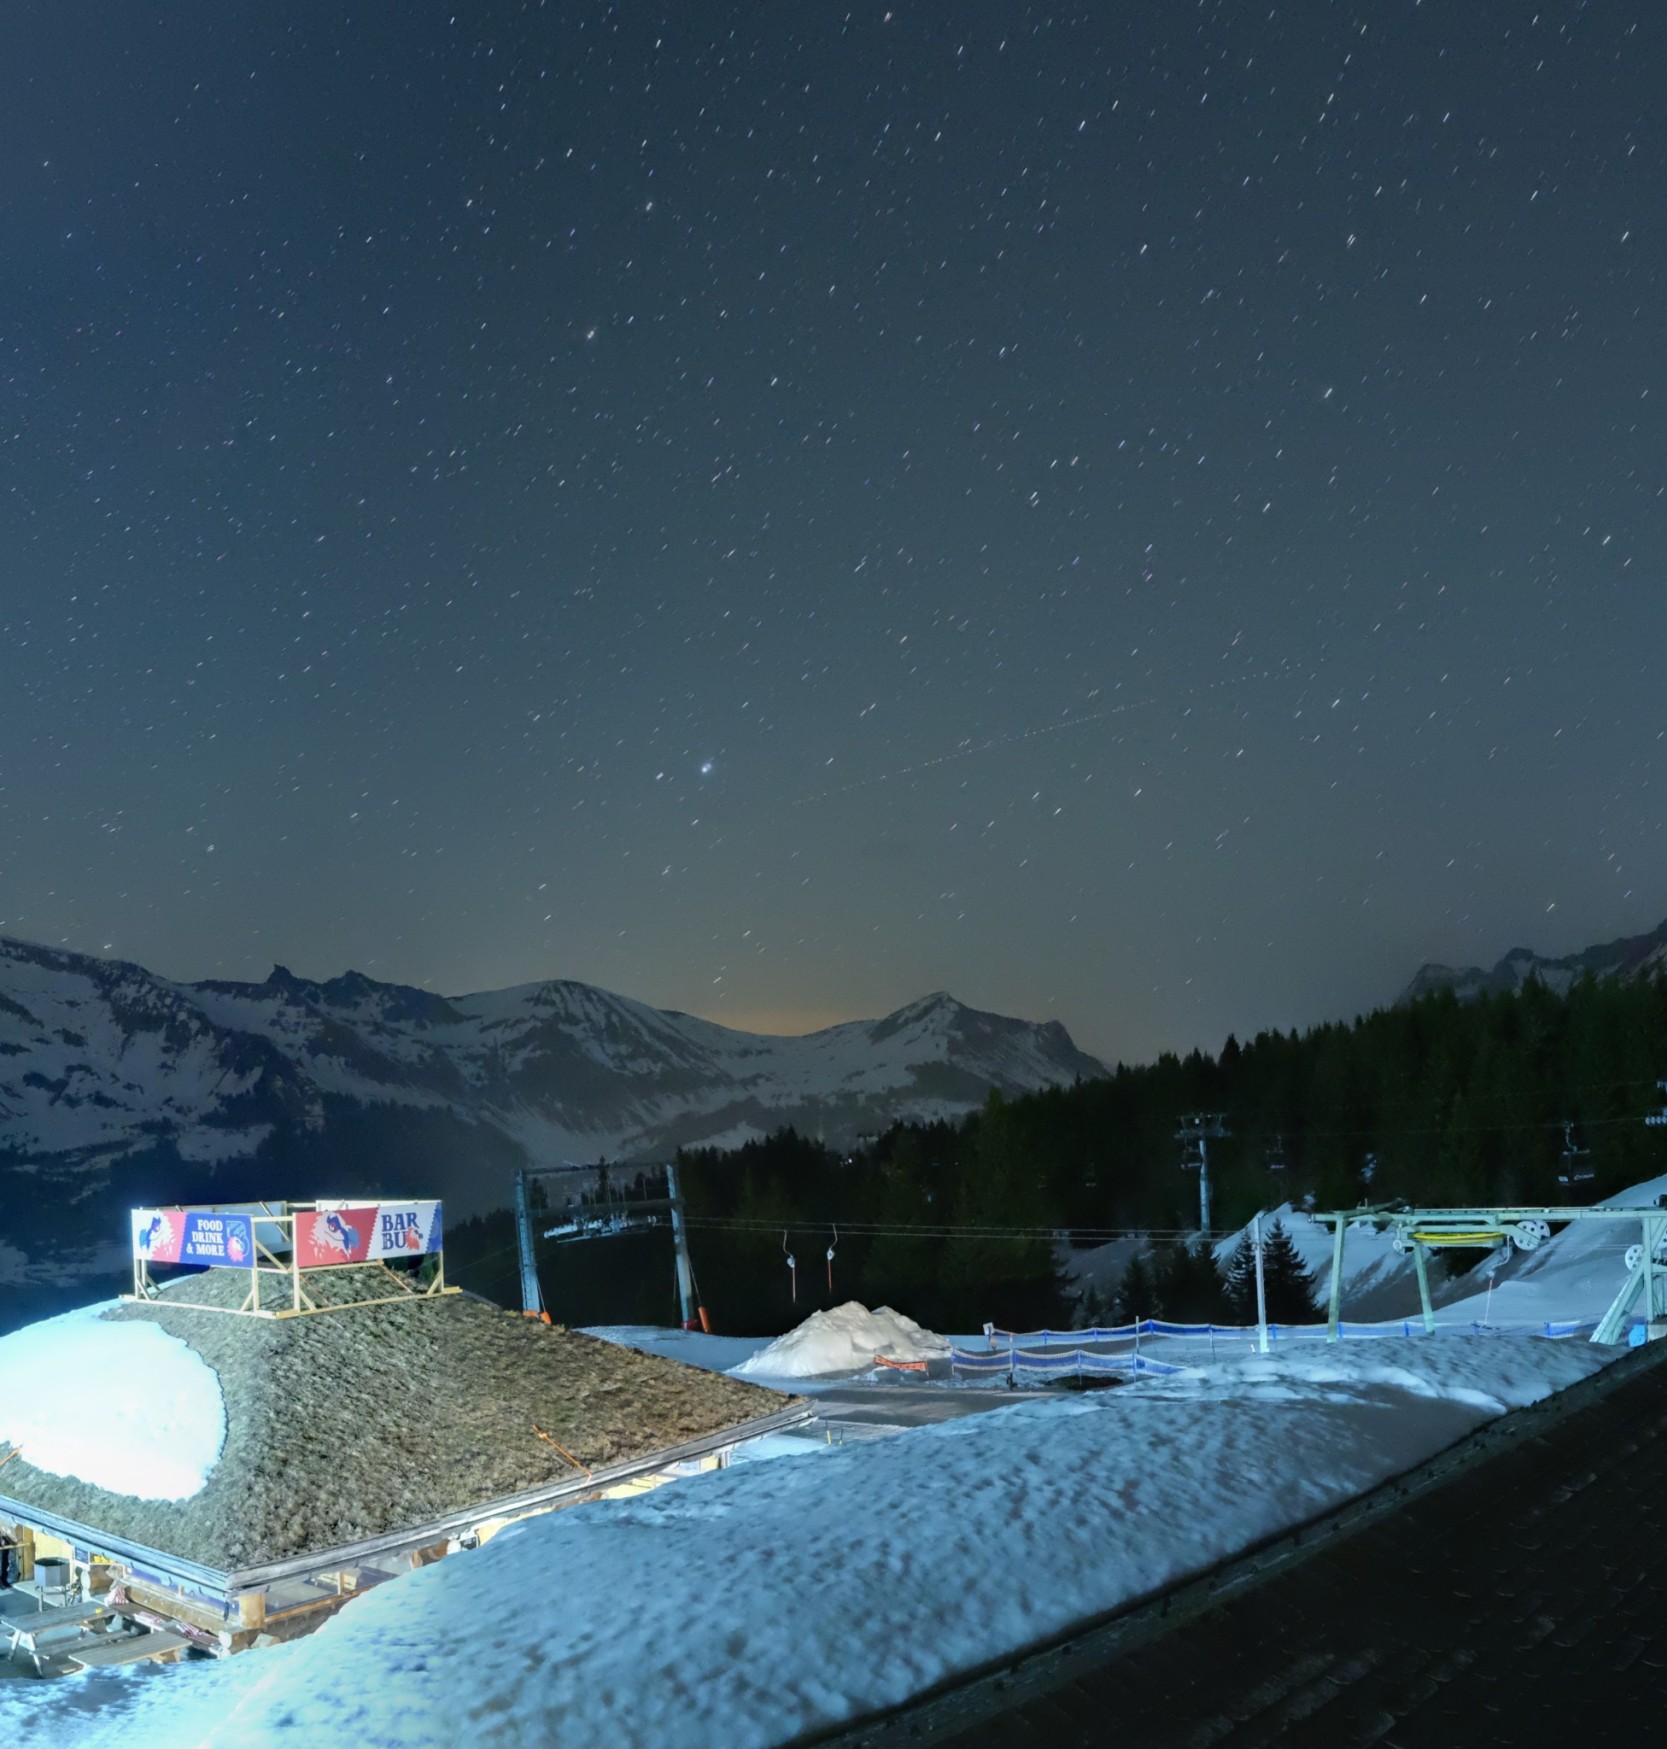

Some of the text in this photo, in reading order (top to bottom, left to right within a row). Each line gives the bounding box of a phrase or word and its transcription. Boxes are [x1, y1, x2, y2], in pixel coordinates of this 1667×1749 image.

[197, 1219, 223, 1231] FOOD
[381, 1212, 419, 1232] BAR
[191, 1231, 224, 1244] DRINK
[186, 1243, 225, 1256] & MORE
